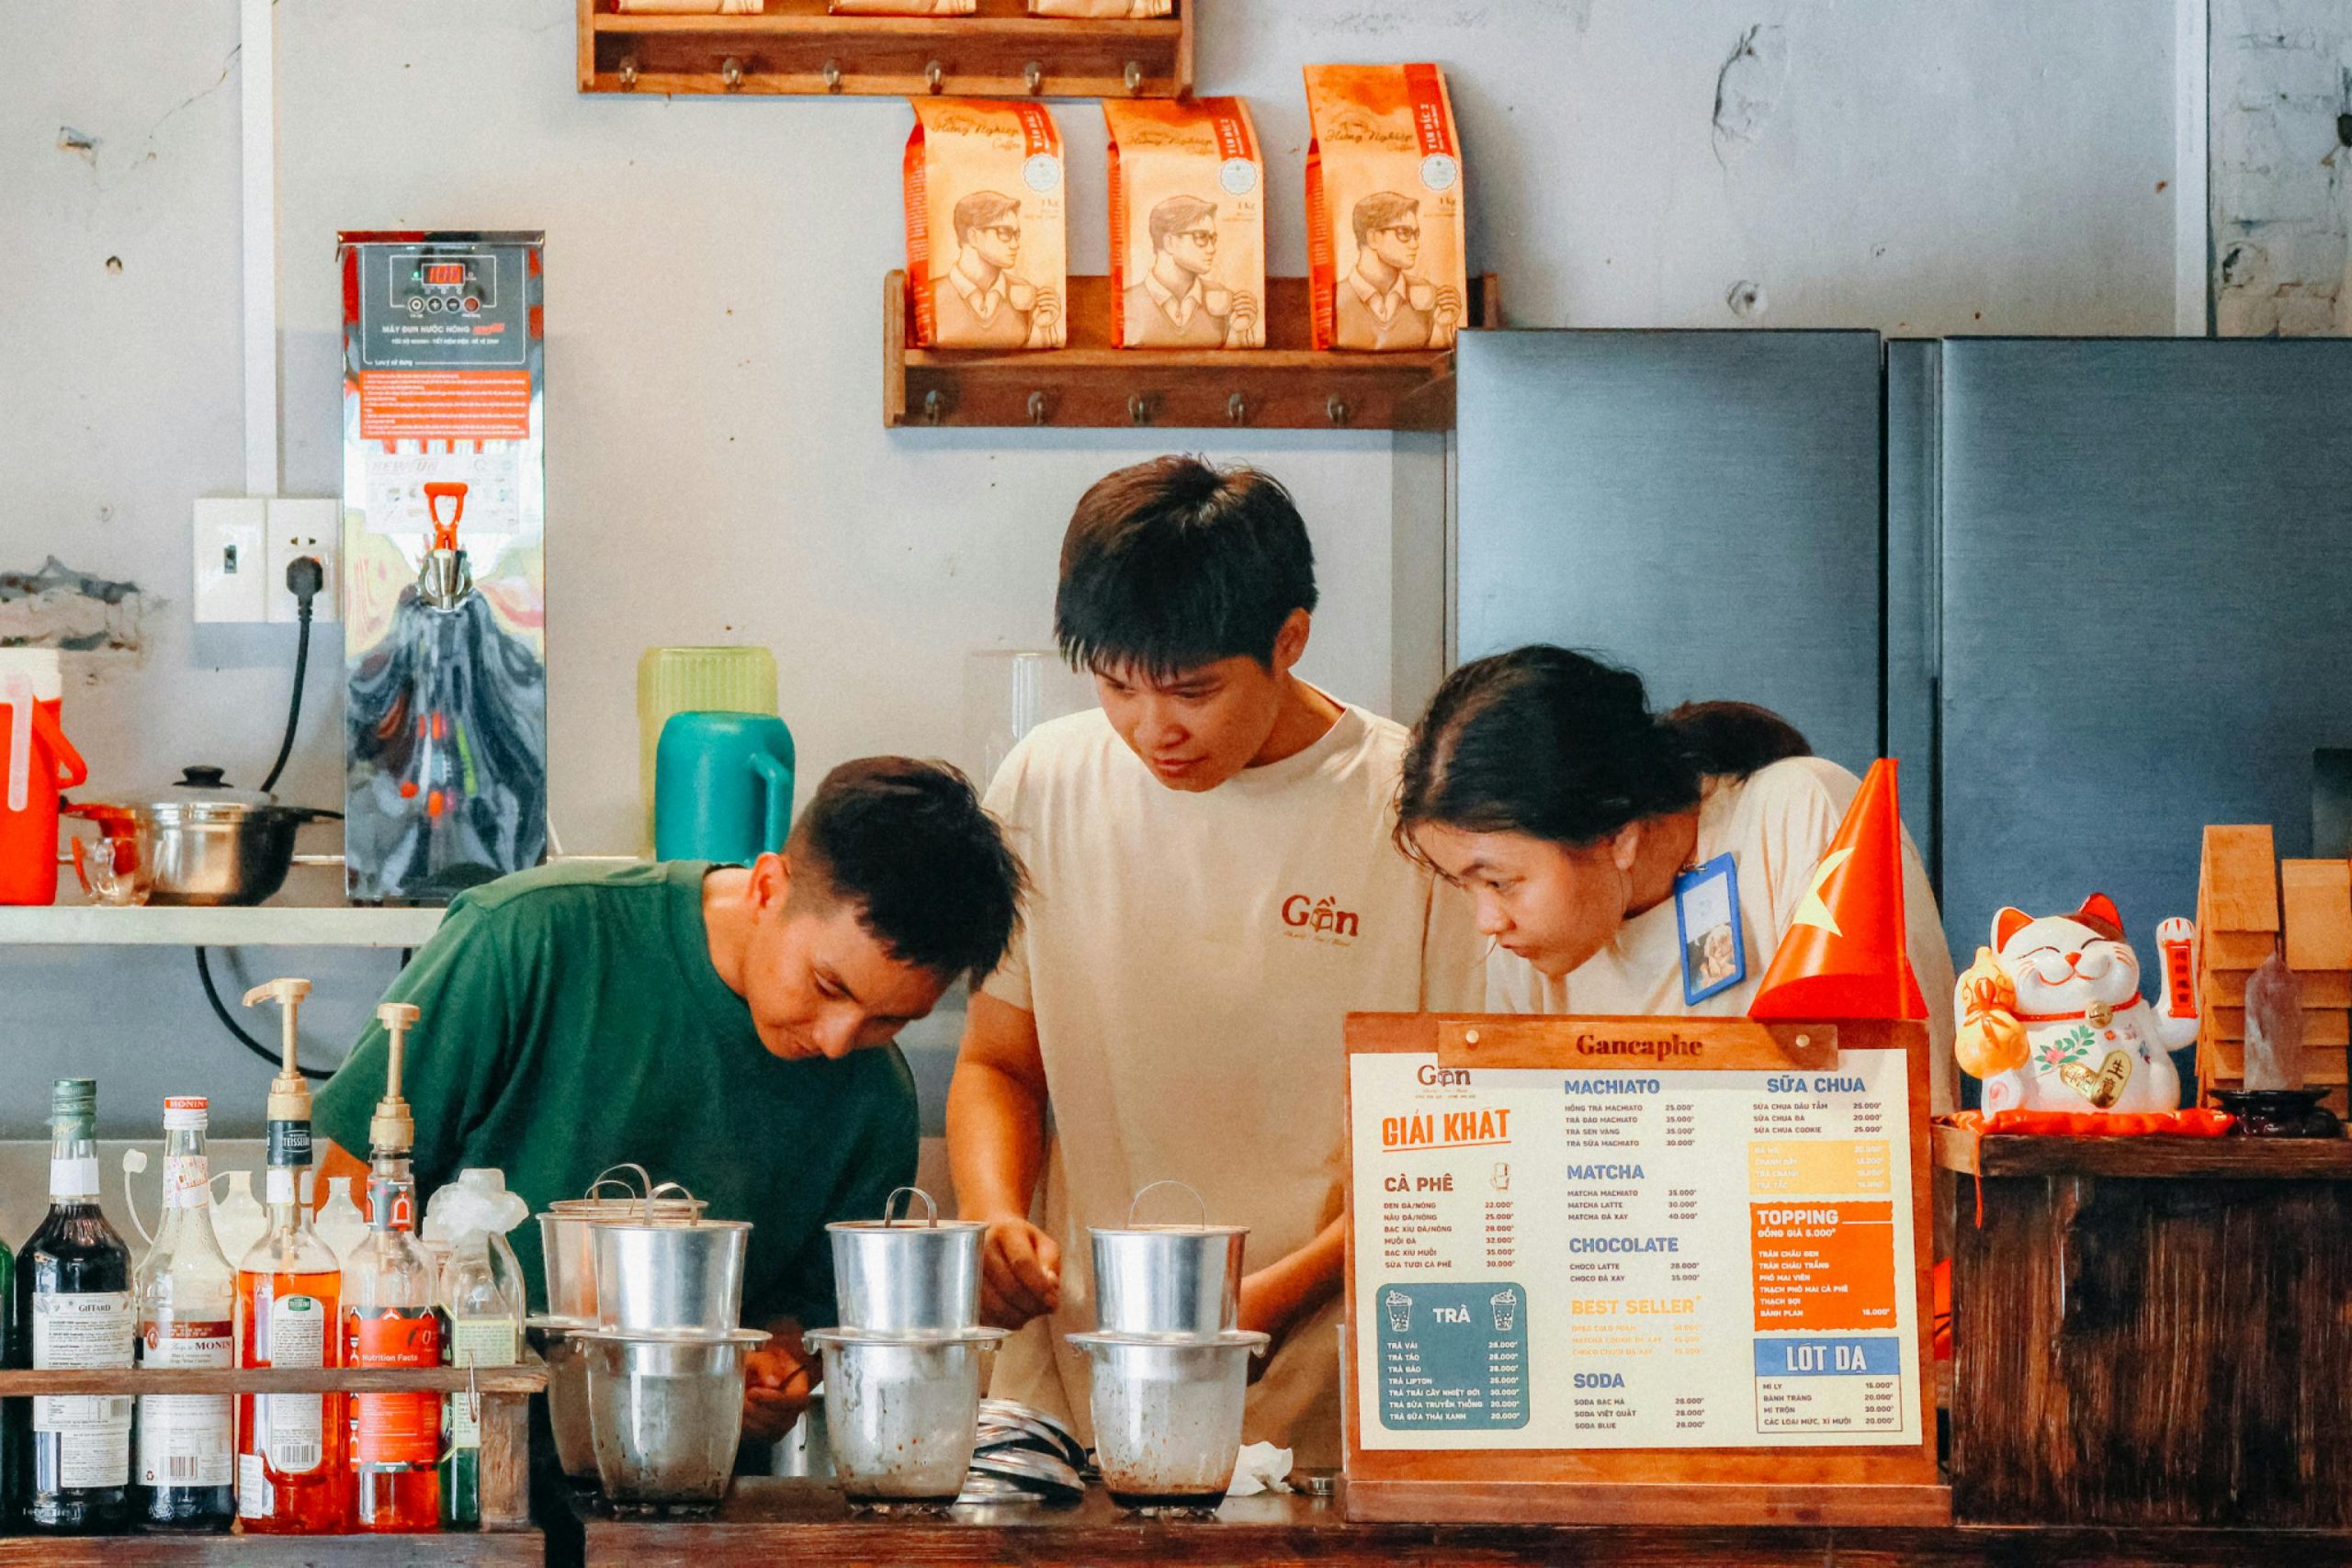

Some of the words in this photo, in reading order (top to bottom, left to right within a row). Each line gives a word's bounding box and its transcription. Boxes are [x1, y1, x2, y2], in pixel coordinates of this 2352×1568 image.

[1576, 1032, 1703, 1062] Gancaphe
[1564, 1078, 1661, 1095] MACHIATO
[1767, 1075, 1808, 1093] SỮA
[1814, 1077, 1866, 1093] CHUA
[1566, 1164, 1645, 1180] MATCHA
[1384, 1173, 1410, 1192] CÀ
[1417, 1173, 1453, 1192] PHÊ
[1757, 1209, 1838, 1225] TOPPING
[1569, 1236, 1679, 1253] CHOCOLATE
[1432, 1304, 1471, 1324] TRÀ
[1571, 1300, 1619, 1315] BEST
[1625, 1298, 1695, 1314] SELLER
[362, 1354, 396, 1362] Nutrition
[397, 1354, 418, 1362] Facts
[1573, 1372, 1625, 1389] SODA
